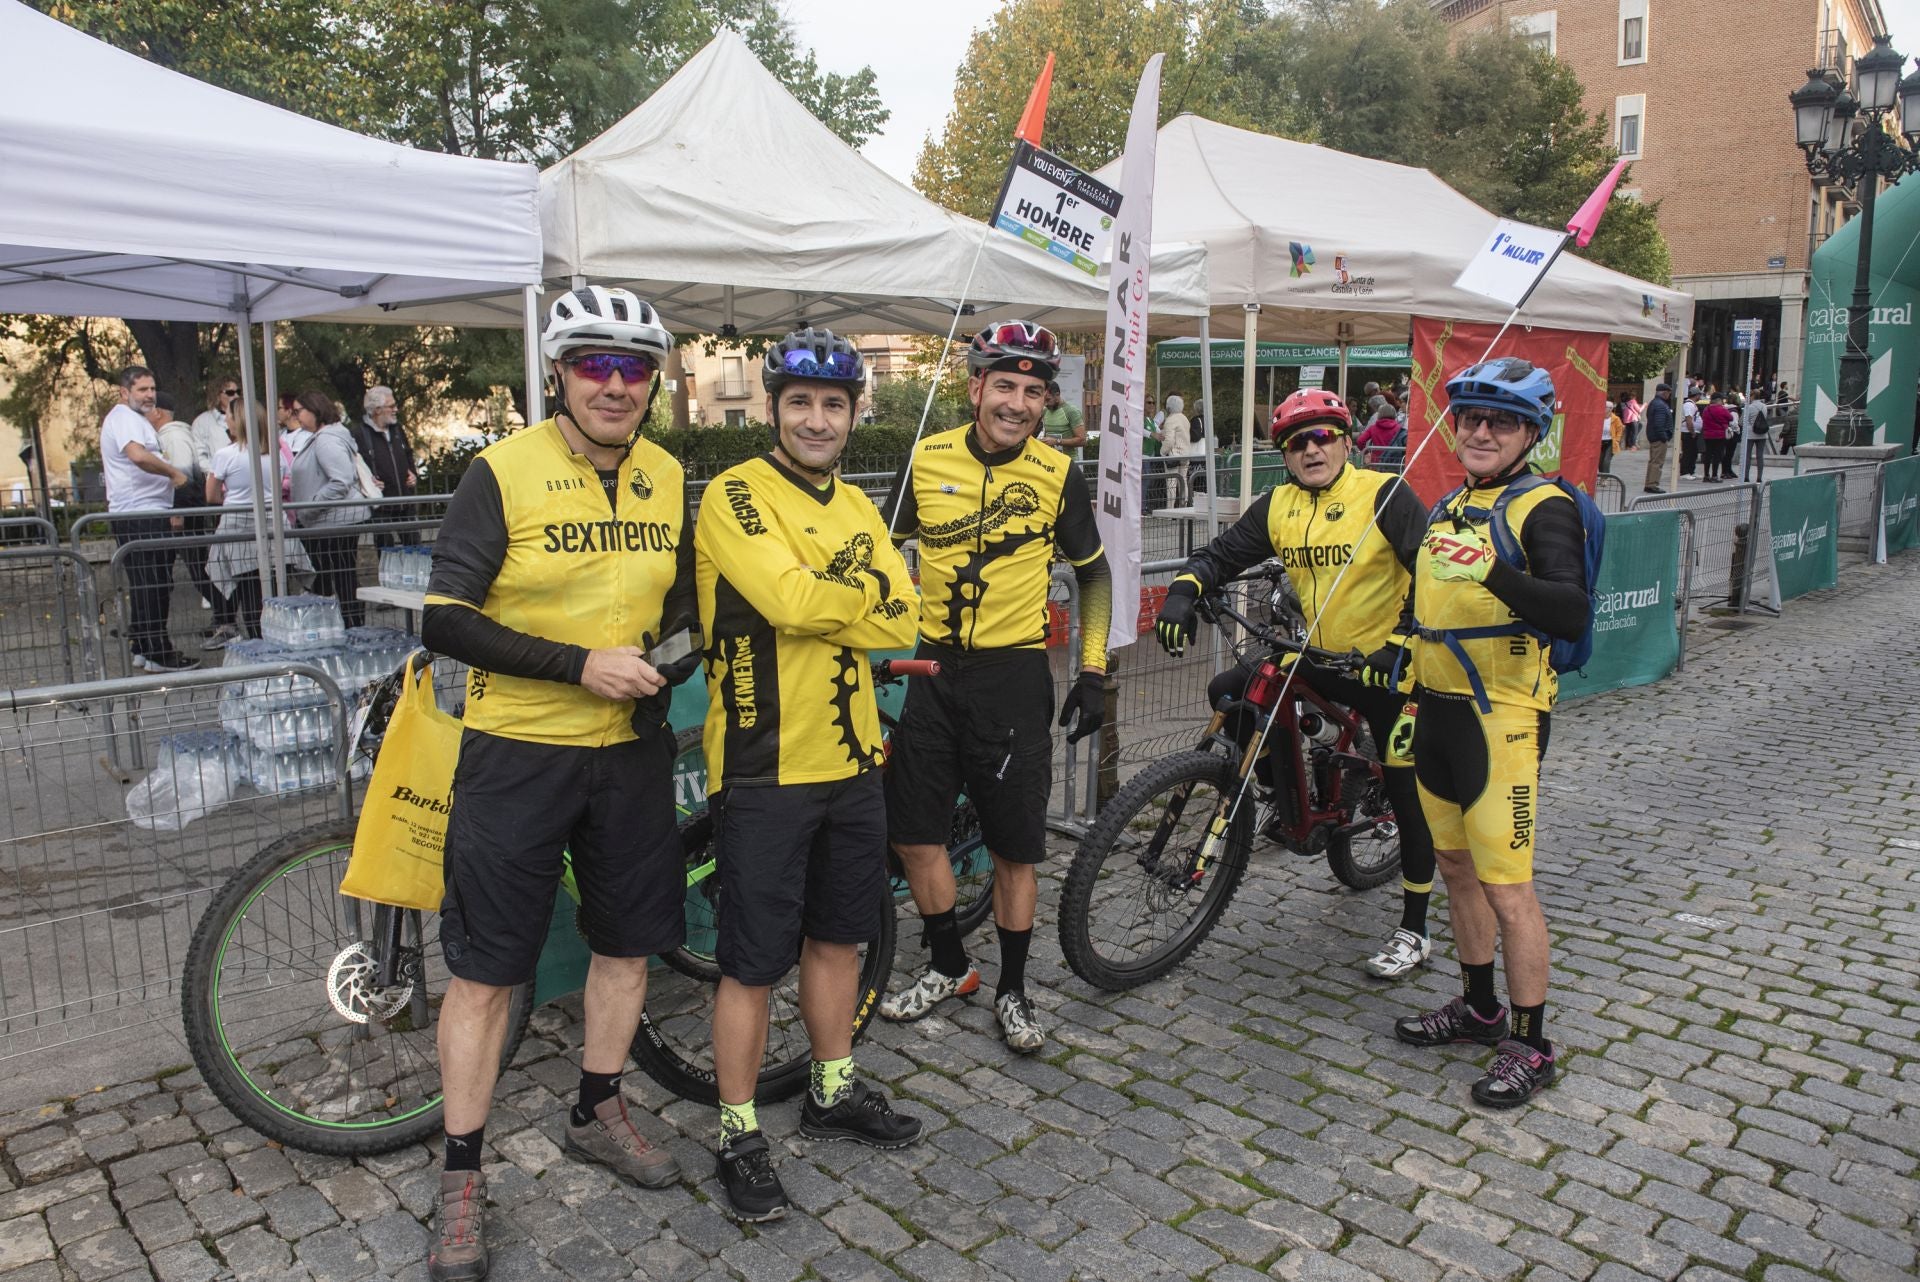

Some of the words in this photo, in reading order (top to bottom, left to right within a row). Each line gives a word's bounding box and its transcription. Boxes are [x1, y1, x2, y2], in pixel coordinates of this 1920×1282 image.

[1015, 198, 1095, 252] HOMBRE
[1502, 244, 1545, 266] MUJER
[1255, 348, 1291, 358] CONTRA
[1292, 348, 1303, 357] EL
[924, 443, 953, 451] SEGOVIA
[546, 477, 586, 492] GOBIK
[1508, 785, 1533, 850] Segovia
[640, 1012, 650, 1025] DT
[646, 1025, 664, 1048] SWISS
